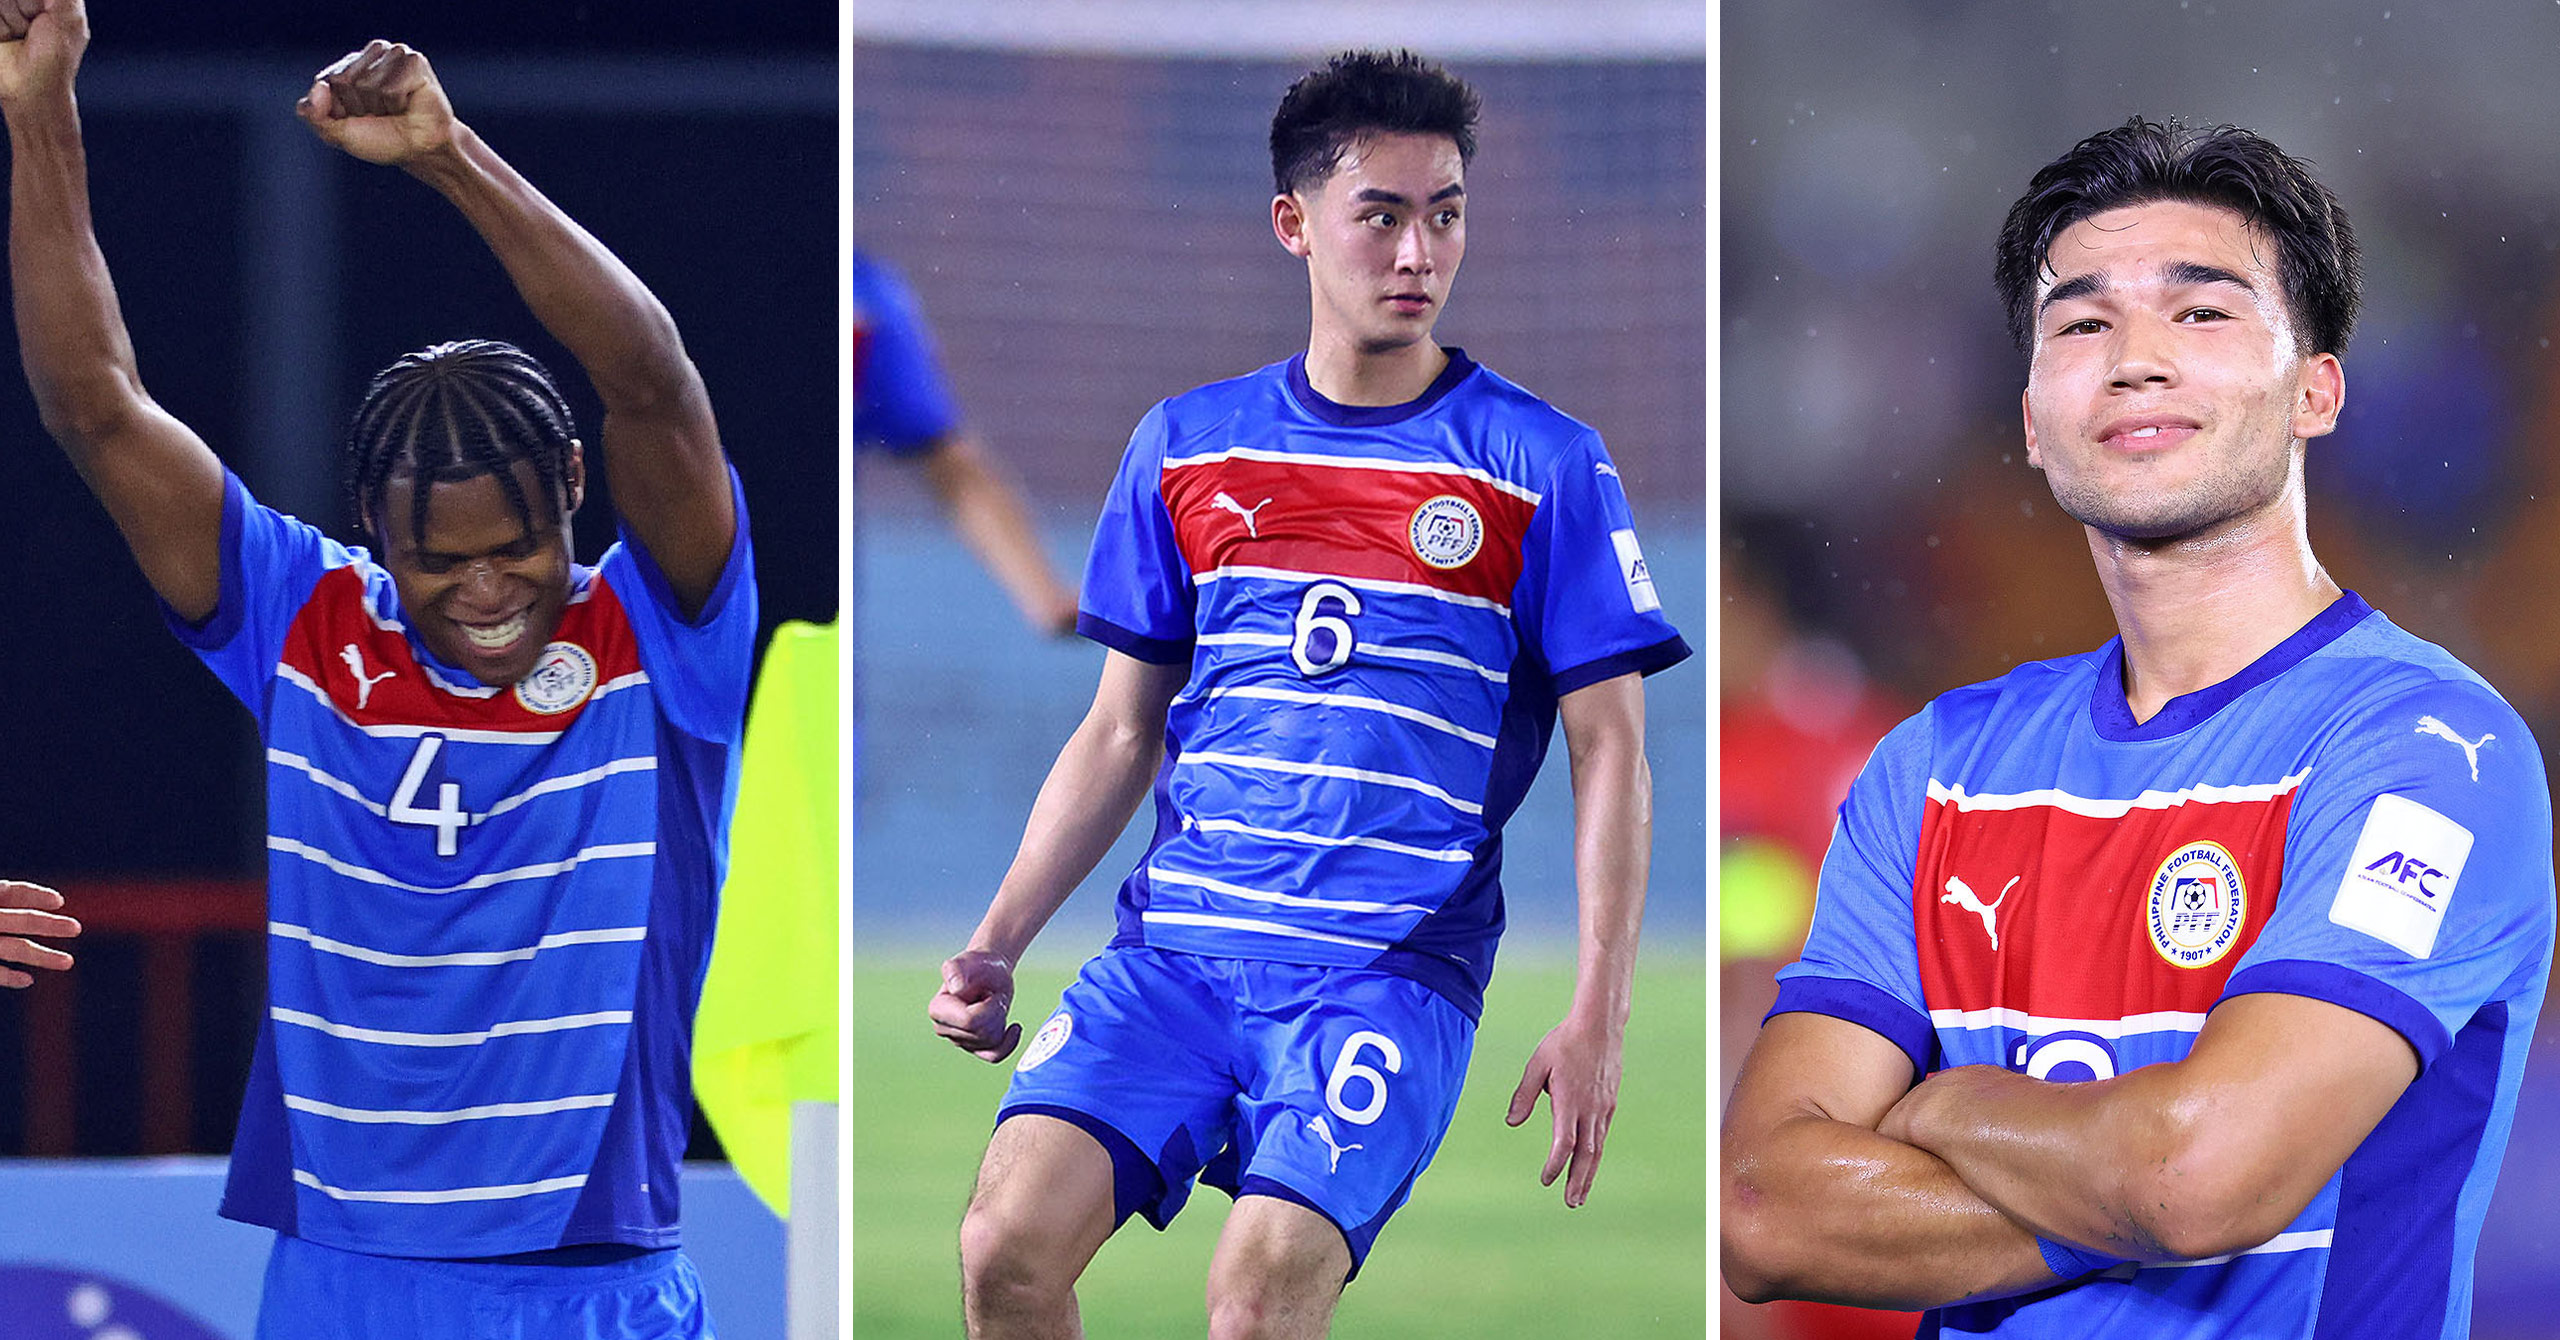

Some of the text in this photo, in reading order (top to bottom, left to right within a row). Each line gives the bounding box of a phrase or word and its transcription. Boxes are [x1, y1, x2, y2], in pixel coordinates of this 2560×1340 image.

[1428, 500, 1469, 515] FOOTBALL
[1457, 513, 1479, 561] FEDERATION
[1292, 583, 1361, 676] 6
[388, 736, 469, 856] 4
[2152, 849, 2240, 949] PHILIPPINE FOOTBALL FEDERATION
[2364, 850, 2443, 899] AFC
[2171, 911, 2221, 933] PFF
[2180, 950, 2204, 961] 1907
[1325, 1030, 1402, 1126] 6
